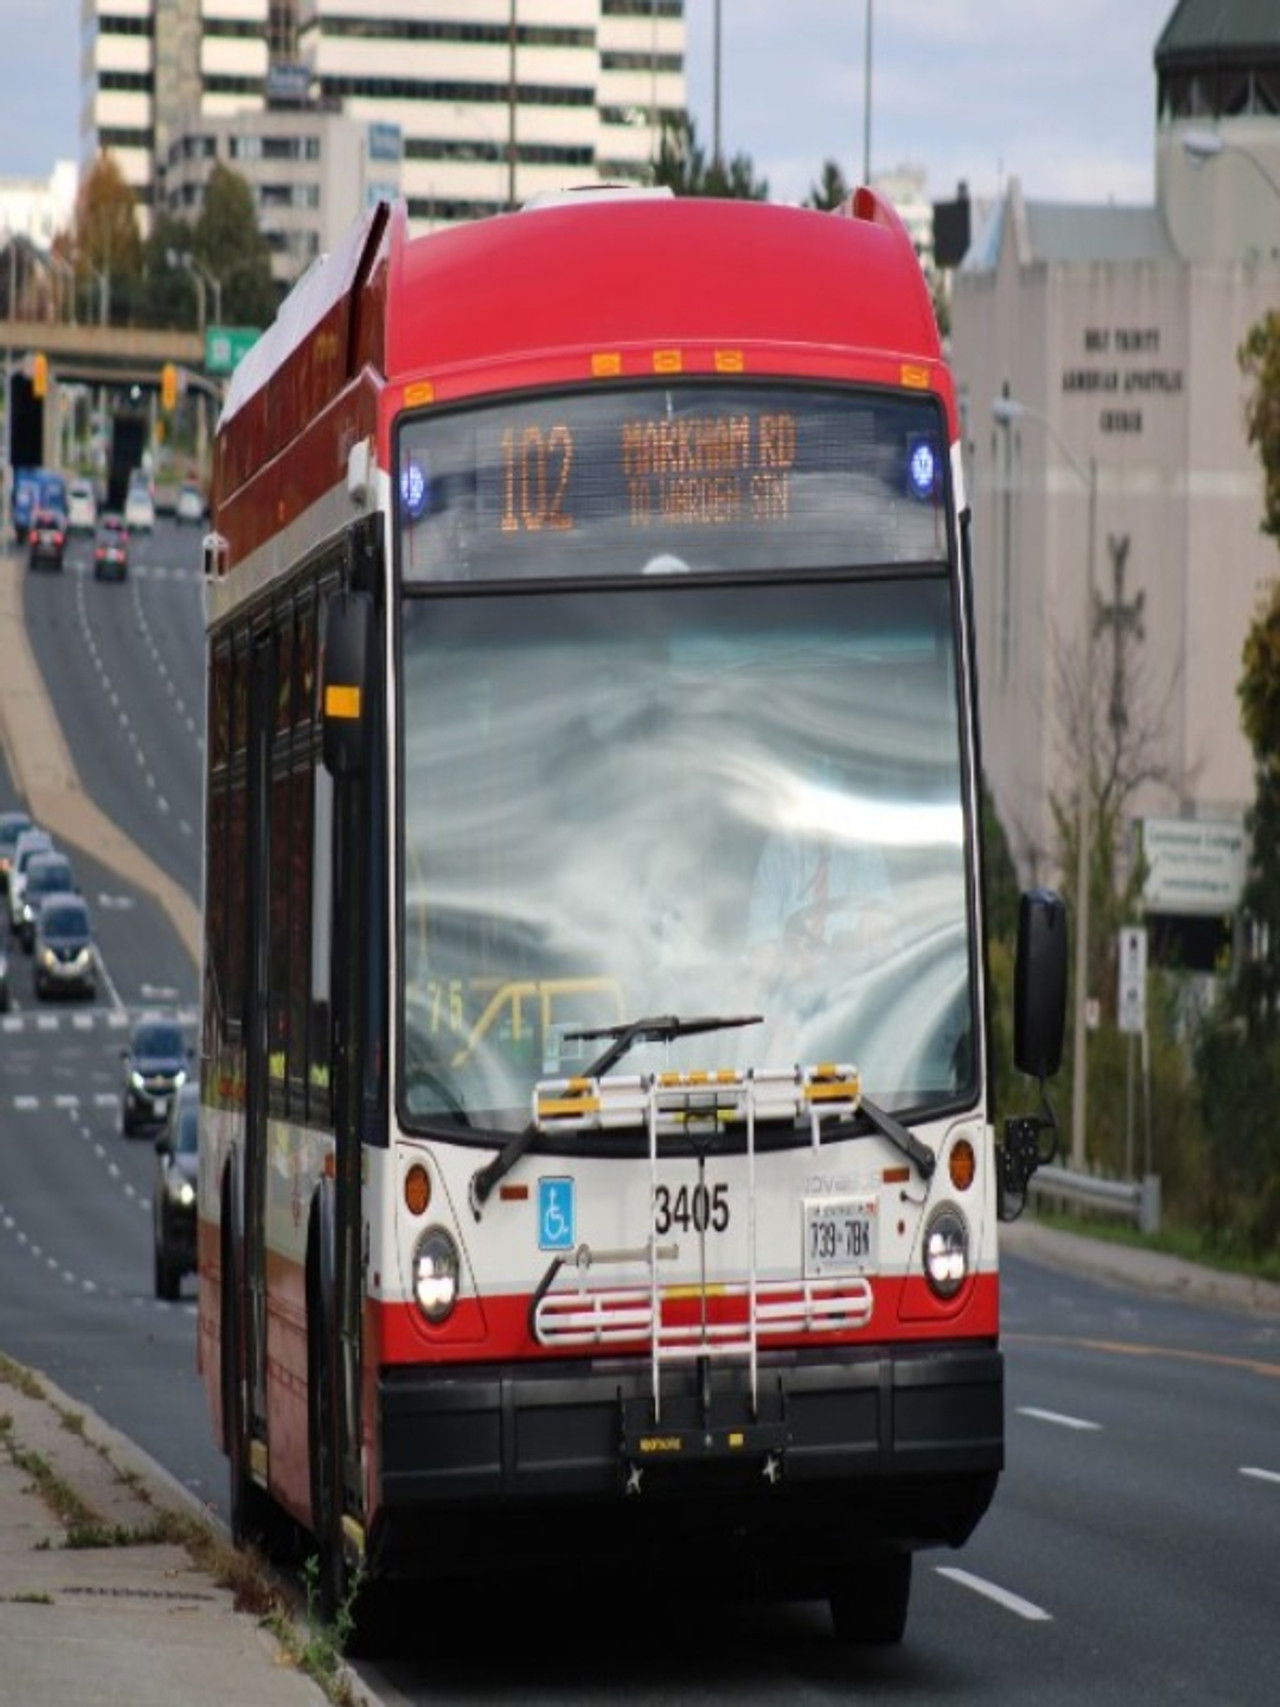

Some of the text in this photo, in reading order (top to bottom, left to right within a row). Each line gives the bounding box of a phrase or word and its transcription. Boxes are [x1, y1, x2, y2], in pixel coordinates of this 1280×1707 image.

[622, 412, 798, 475] MARKHAM RD
[501, 425, 574, 532] 102
[655, 1183, 729, 1235] 3405
